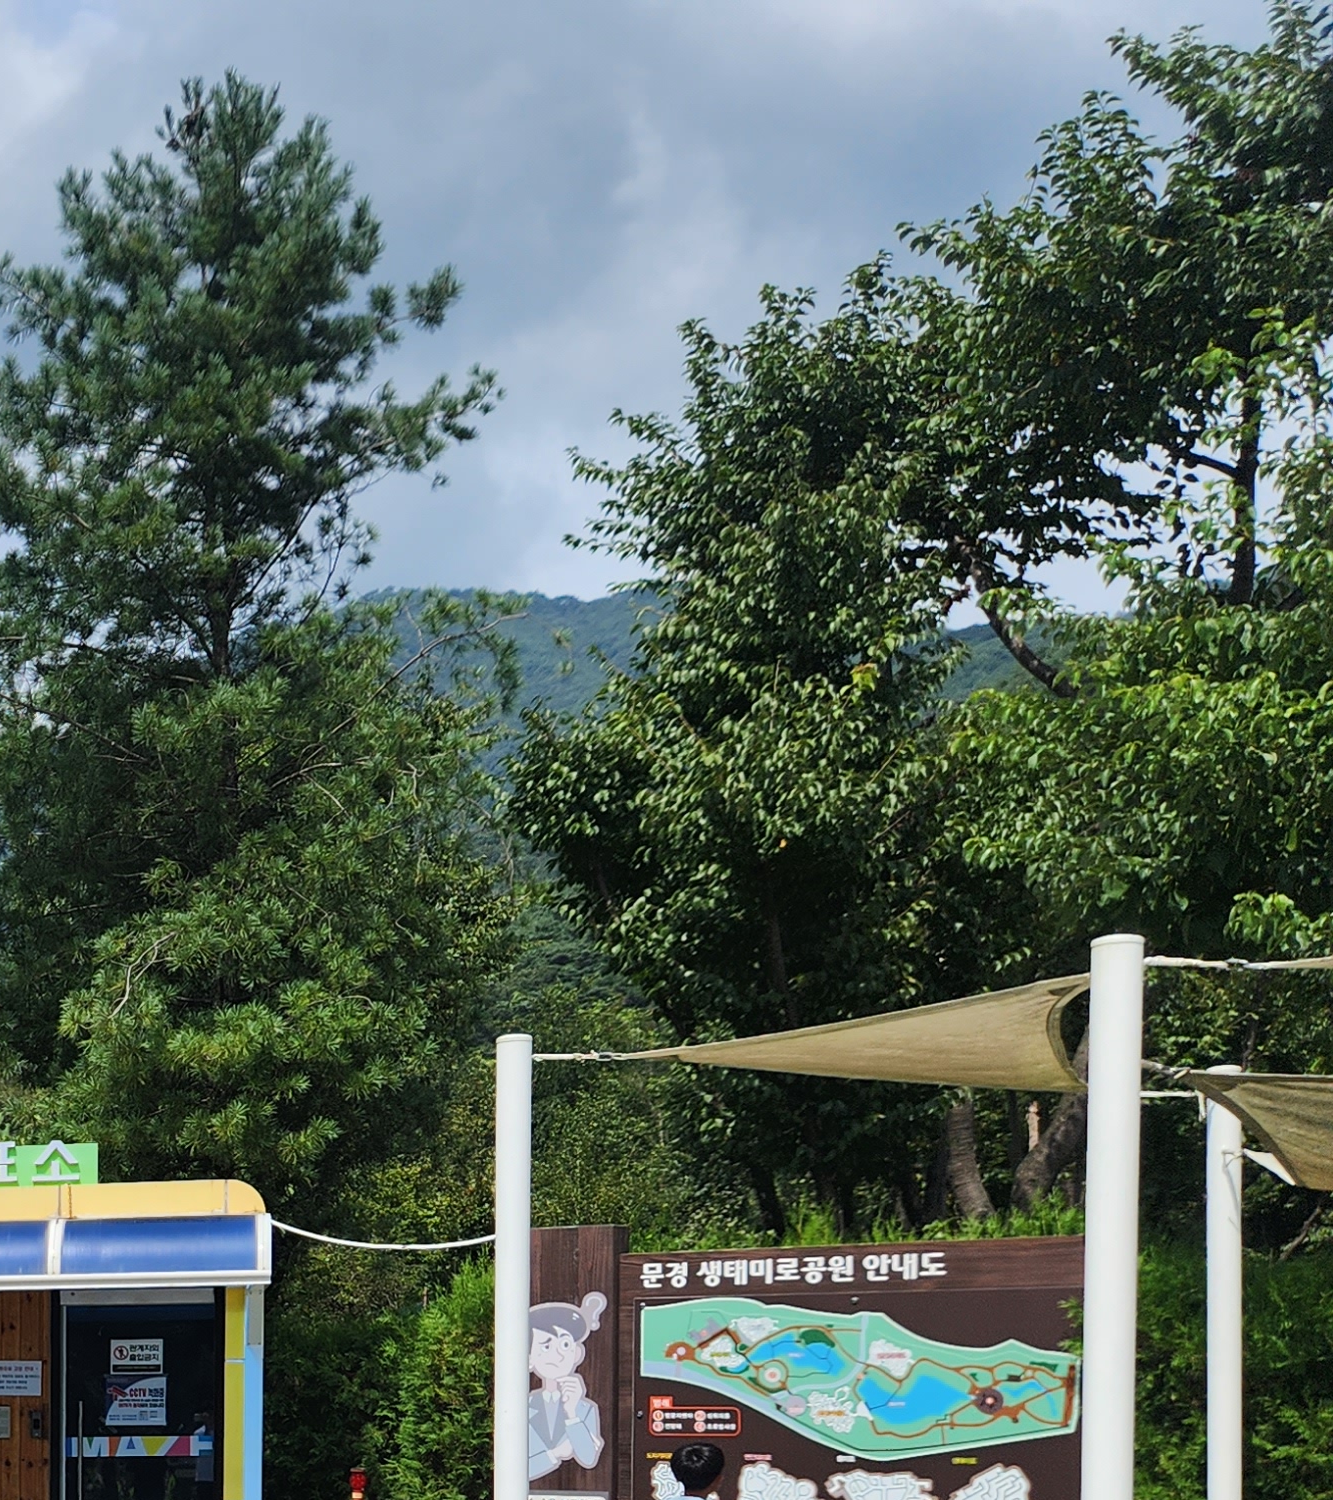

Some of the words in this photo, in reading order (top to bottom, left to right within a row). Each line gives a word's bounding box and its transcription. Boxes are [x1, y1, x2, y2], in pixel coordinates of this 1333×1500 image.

[639, 1262, 688, 1288] 문경
[696, 1255, 855, 1287] 생태미로공원
[862, 1252, 947, 1282] 안내도
[129, 1388, 147, 1398] CCTV
